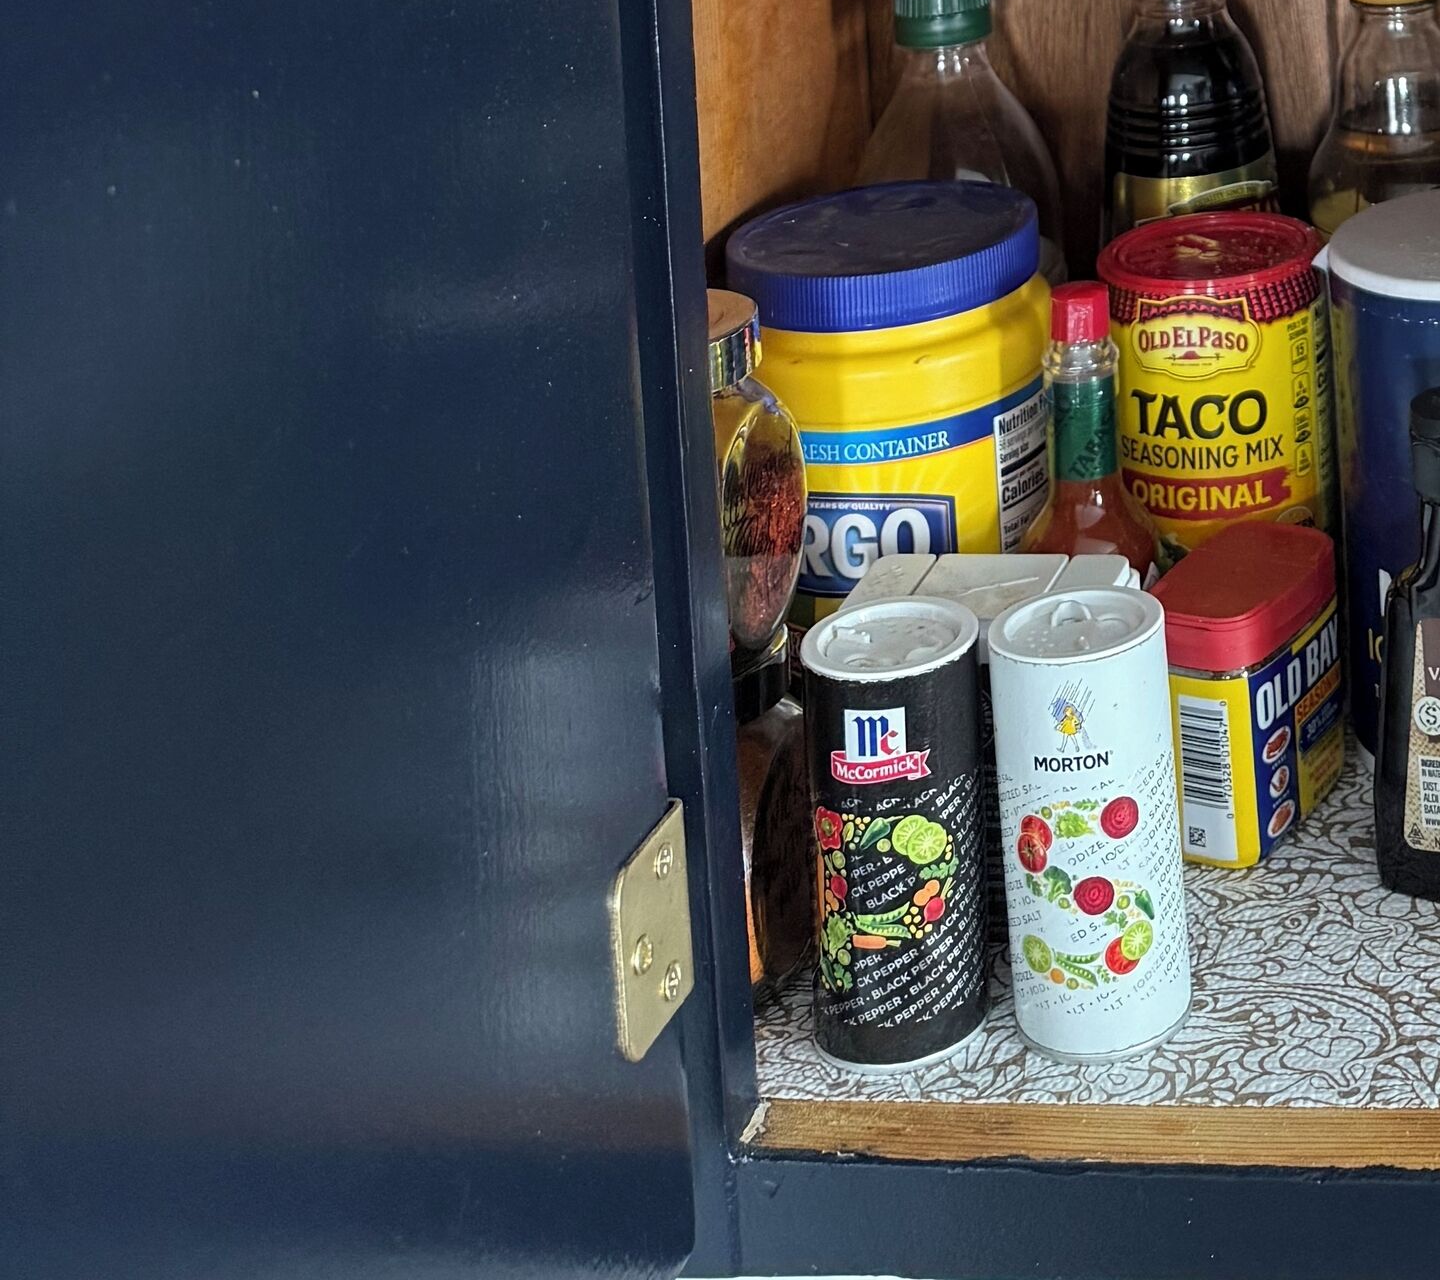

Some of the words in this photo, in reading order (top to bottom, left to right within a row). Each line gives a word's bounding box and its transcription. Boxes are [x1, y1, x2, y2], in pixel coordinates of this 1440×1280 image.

[1139, 328, 1170, 353] OLD
[1172, 326, 1198, 349] EL
[1131, 389, 1268, 440] TACO
[803, 444, 839, 461] RESH
[844, 431, 950, 460] CONTAINER
[1120, 435, 1239, 470] SEASONING
[1246, 435, 1284, 466] MIX
[1002, 467, 1045, 504] Calories
[1132, 479, 1271, 511] ORIGINAL
[801, 508, 930, 579] RGO
[1256, 657, 1301, 730] OLD
[1306, 614, 1339, 688] BAY
[834, 759, 917, 780] McCormick
[1034, 752, 1110, 773] MORTON
